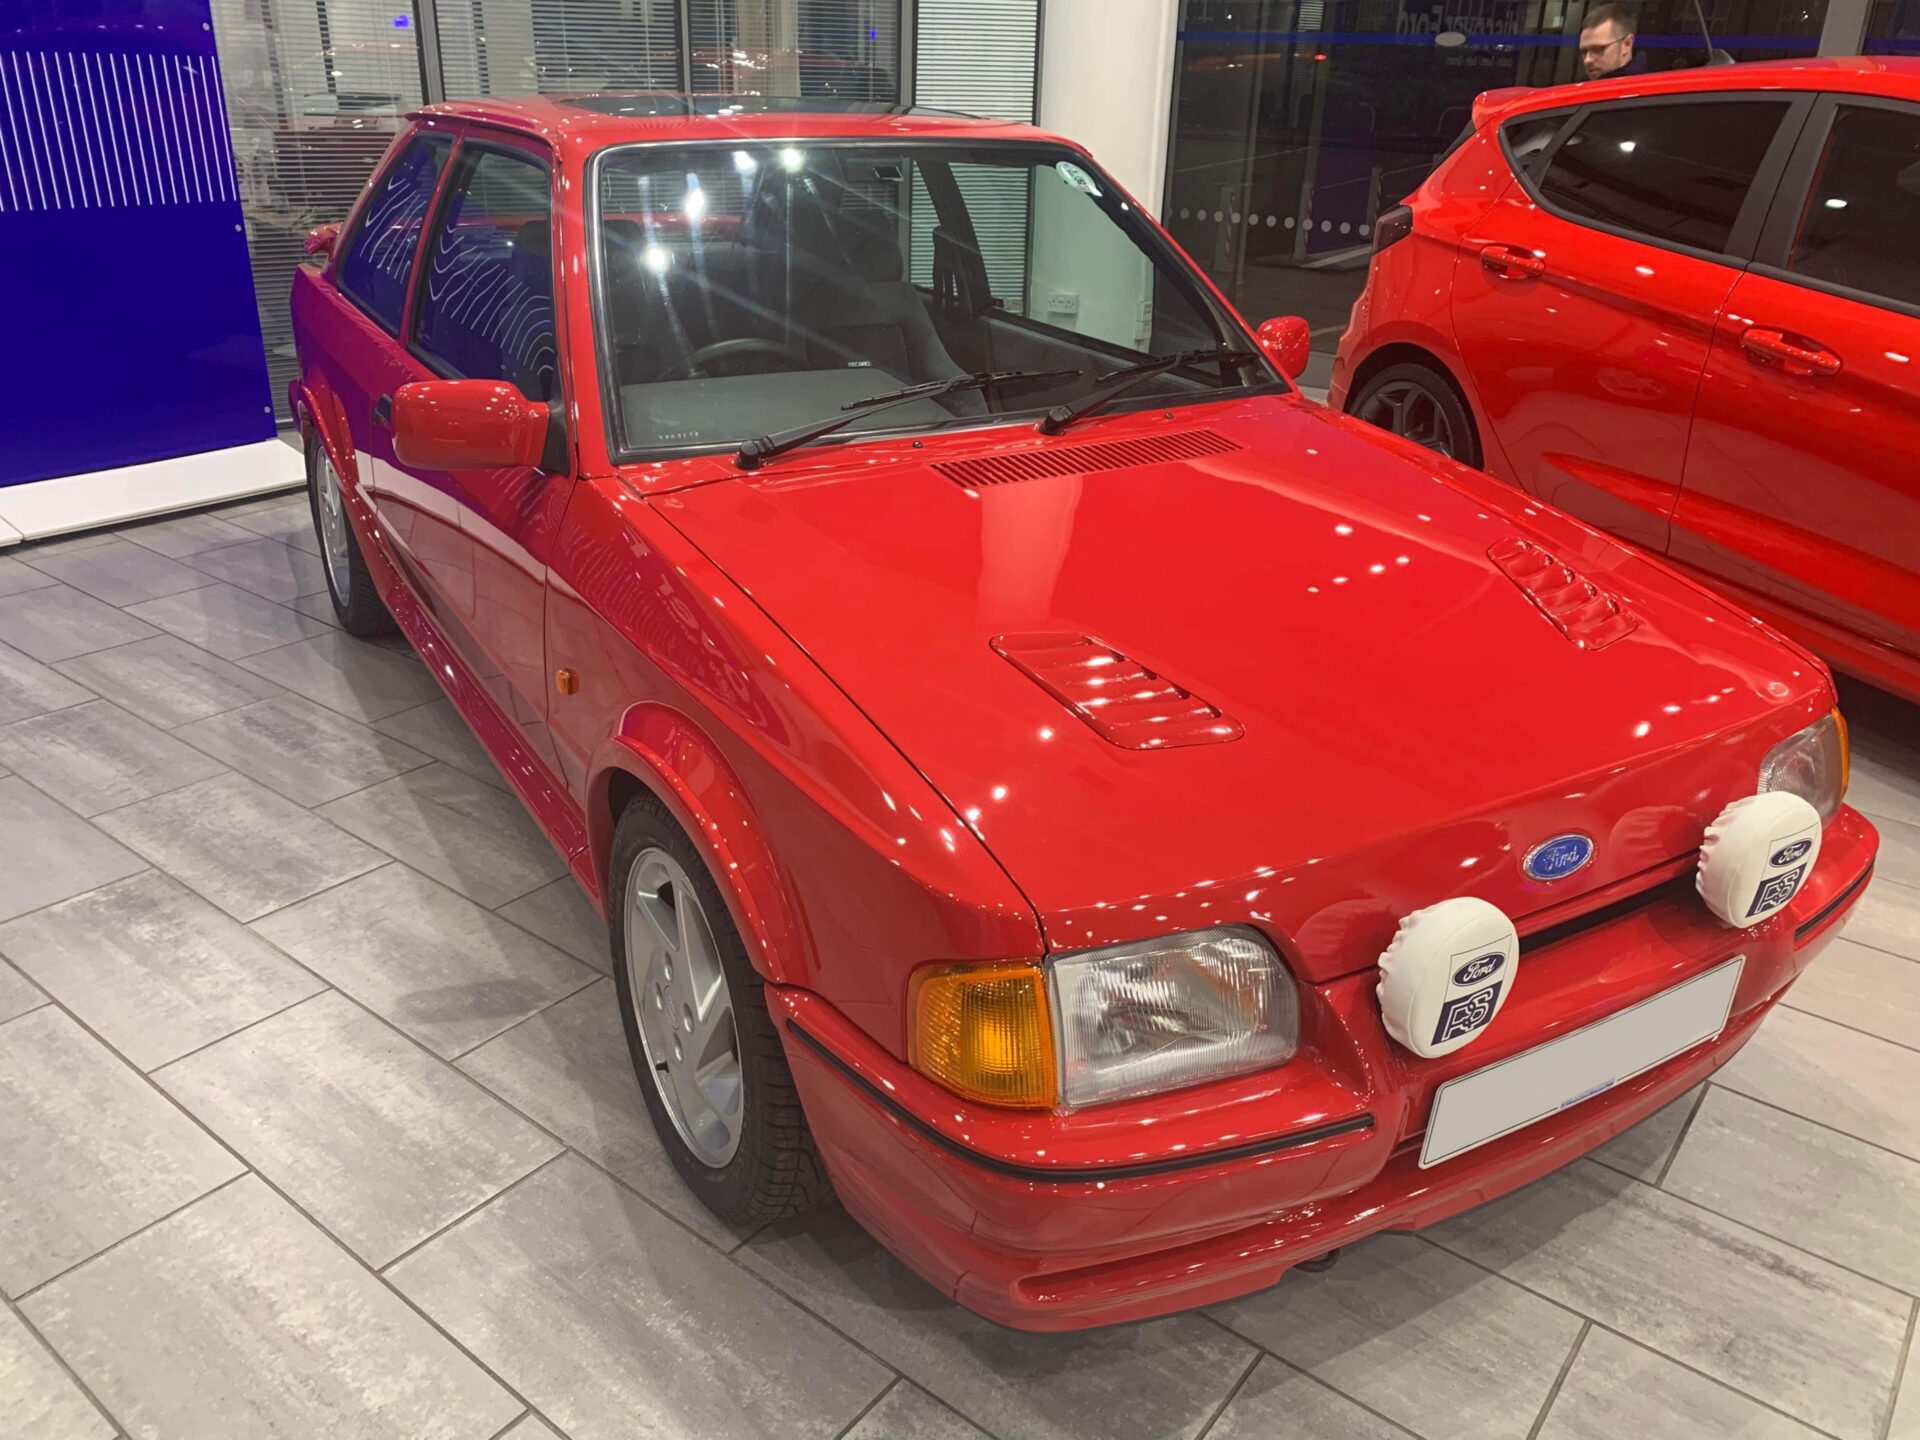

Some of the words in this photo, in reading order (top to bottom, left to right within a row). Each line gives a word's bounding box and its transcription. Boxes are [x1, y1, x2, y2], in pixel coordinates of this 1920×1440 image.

[1543, 845, 1579, 871] Ford
[1778, 843, 1807, 864] Ford
[1754, 868, 1801, 915] RS
[1463, 957, 1497, 982] Ford
[1441, 987, 1494, 1042] RS
